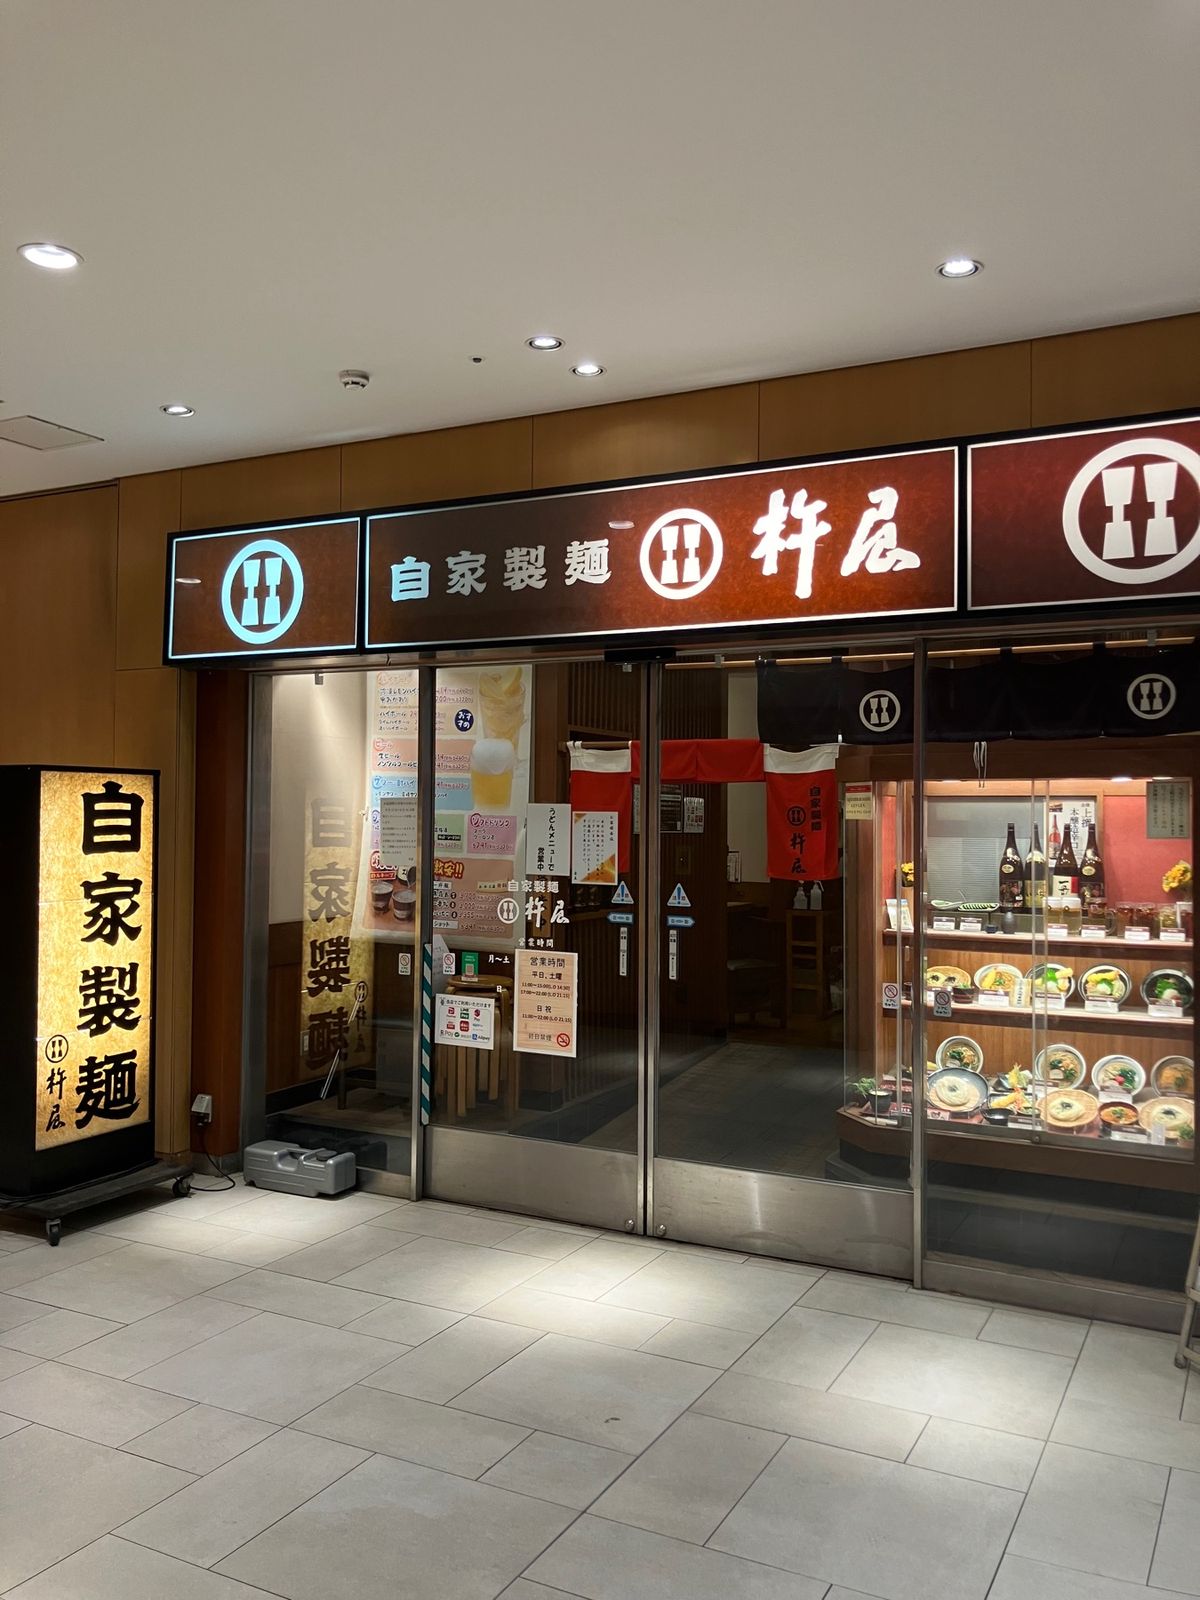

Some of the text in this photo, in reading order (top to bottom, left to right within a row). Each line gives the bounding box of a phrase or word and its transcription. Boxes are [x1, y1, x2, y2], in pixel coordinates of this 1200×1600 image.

[390, 486, 922, 602] 自家製麺 杵屋
[809, 786, 822, 832] 自家製麺
[536, 847, 545, 871] 営業中
[548, 807, 557, 872] うどんメニューで
[507, 880, 560, 894] 自家製麺
[525, 896, 570, 928] 杵屋
[75, 780, 145, 1130] 自家製麺
[529, 956, 566, 969] 営業時間
[531, 971, 563, 981] 平日、土曜
[45, 1067, 68, 1133] 杵屋
